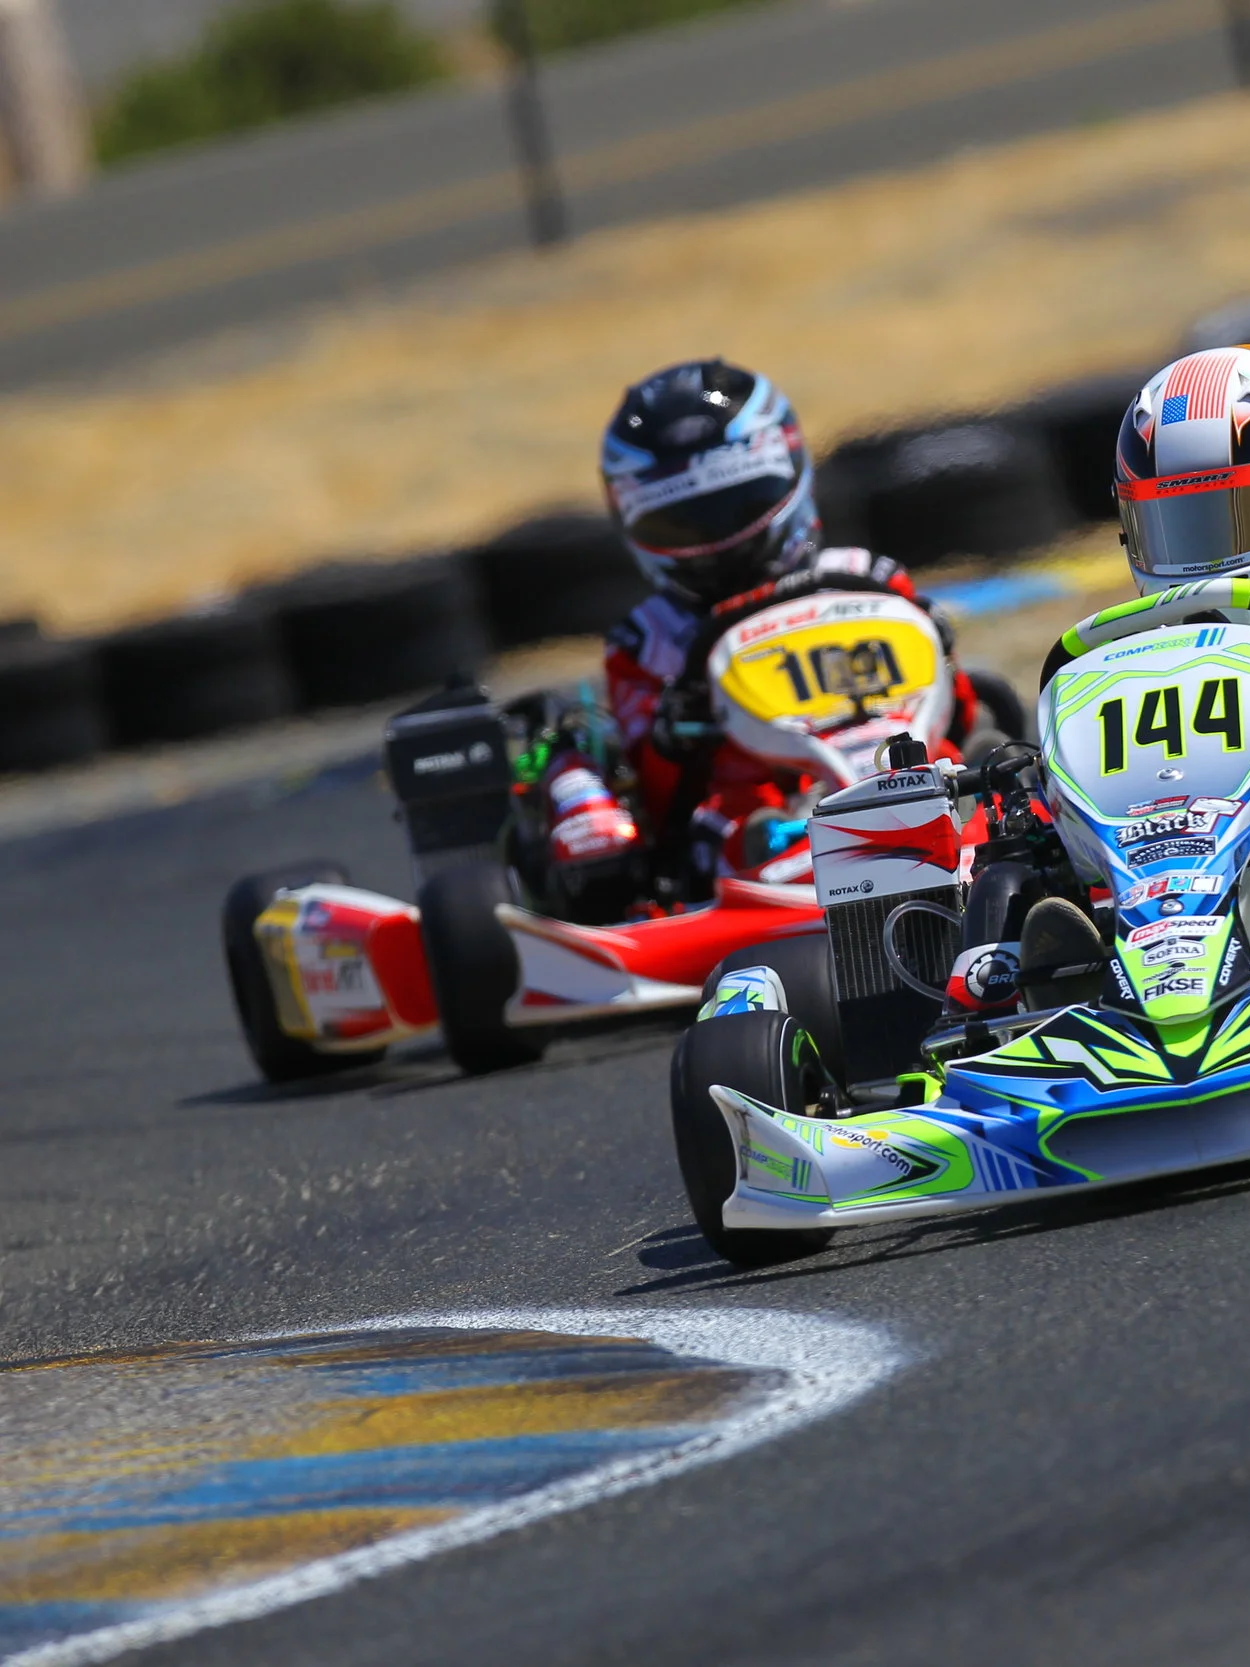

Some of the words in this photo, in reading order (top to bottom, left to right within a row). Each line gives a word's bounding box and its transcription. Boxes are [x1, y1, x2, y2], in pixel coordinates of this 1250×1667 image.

[1156, 472, 1235, 489] SMART
[1183, 556, 1244, 573] motorsport.com
[1103, 635, 1199, 662] COMPKART
[1095, 677, 1245, 777] 144
[877, 773, 926, 791] ROTAX
[1114, 809, 1208, 848] Black
[829, 885, 860, 897] ROTAX
[1147, 944, 1200, 963] SOFINA
[1219, 937, 1242, 986] COVERT
[1110, 959, 1136, 1000] COVERT
[1144, 978, 1204, 1001] FIKSE
[822, 1122, 912, 1177] motorsport.com
